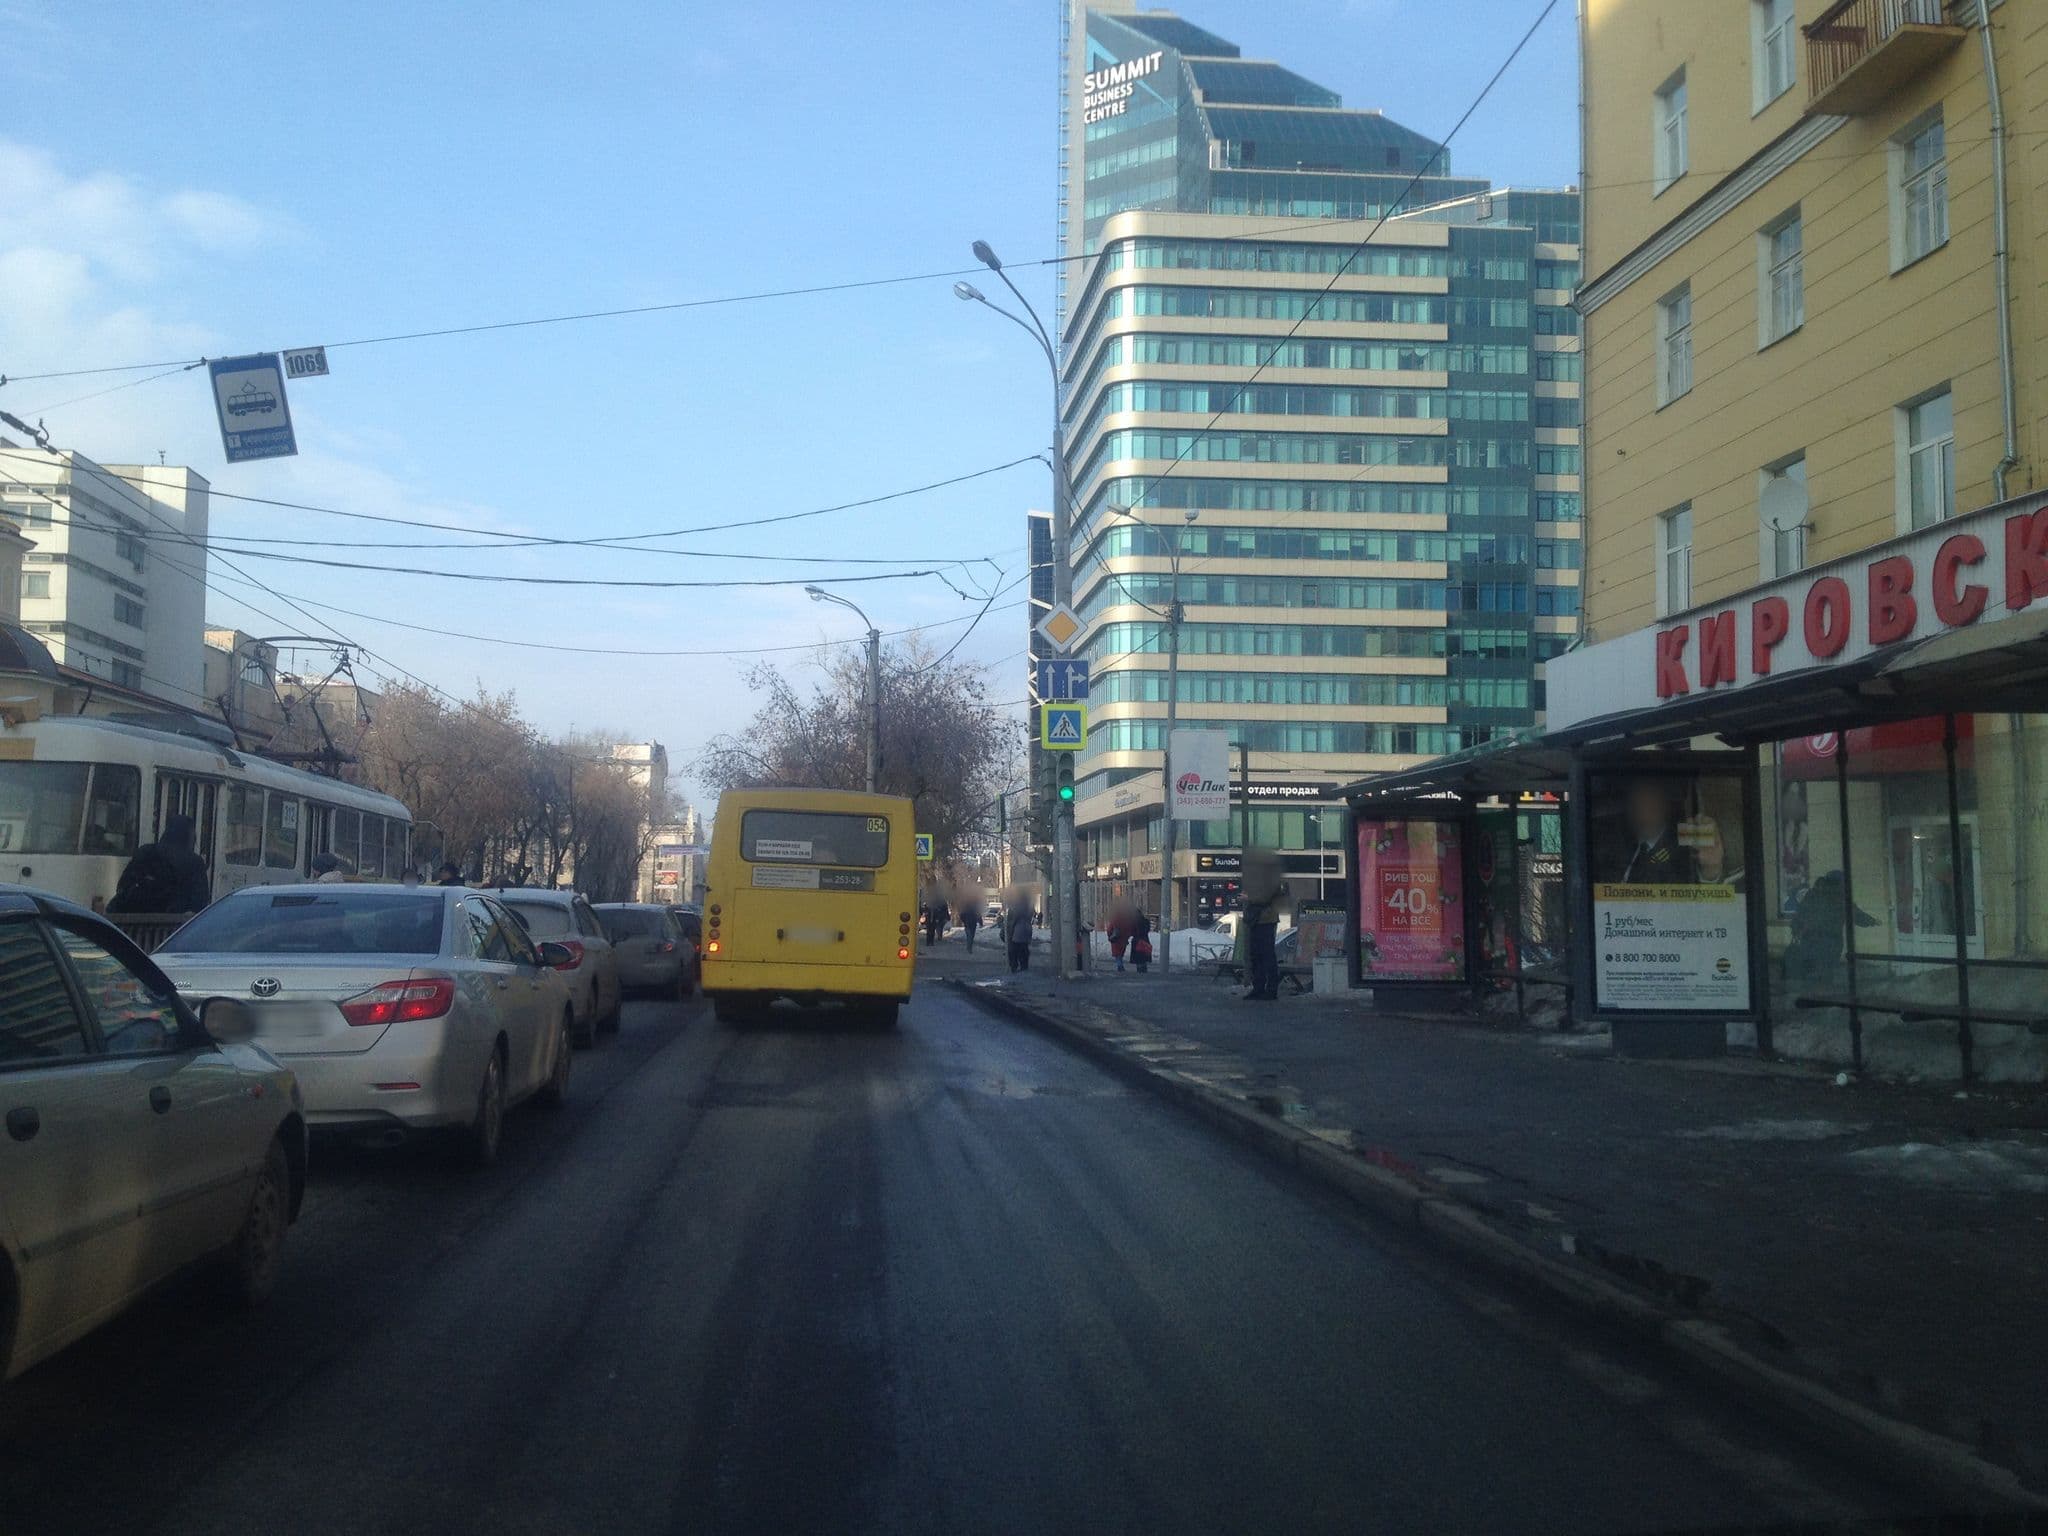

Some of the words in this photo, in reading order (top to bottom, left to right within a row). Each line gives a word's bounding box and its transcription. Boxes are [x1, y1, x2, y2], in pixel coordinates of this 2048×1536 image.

[1084, 51, 1163, 94] SUMMIT
[1084, 82, 1133, 109] BUSINESS
[1084, 100, 1127, 124] CENTRE
[1247, 786, 1277, 795] отдел
[1279, 786, 1319, 797] продаж
[868, 819, 885, 831] 054
[1384, 873, 1409, 882] РИВ
[1411, 872, 1436, 882] ГОШ
[1603, 886, 1656, 898] Позвони,
[1660, 889, 1668, 897] и
[1671, 889, 1731, 900] получишь
[1392, 916, 1408, 925] НА
[1410, 916, 1432, 925] ВСЕ
[1604, 911, 1612, 925] 1
[1615, 916, 1653, 928] руб/мес
[1604, 927, 1656, 940] Домашний
[1659, 930, 1703, 940] интернет
[1715, 928, 1728, 938] ТВ
[1615, 954, 1621, 962] 8
[1623, 954, 1639, 962] 800
[1642, 954, 1657, 962] 700
[1659, 954, 1680, 962] 8000
